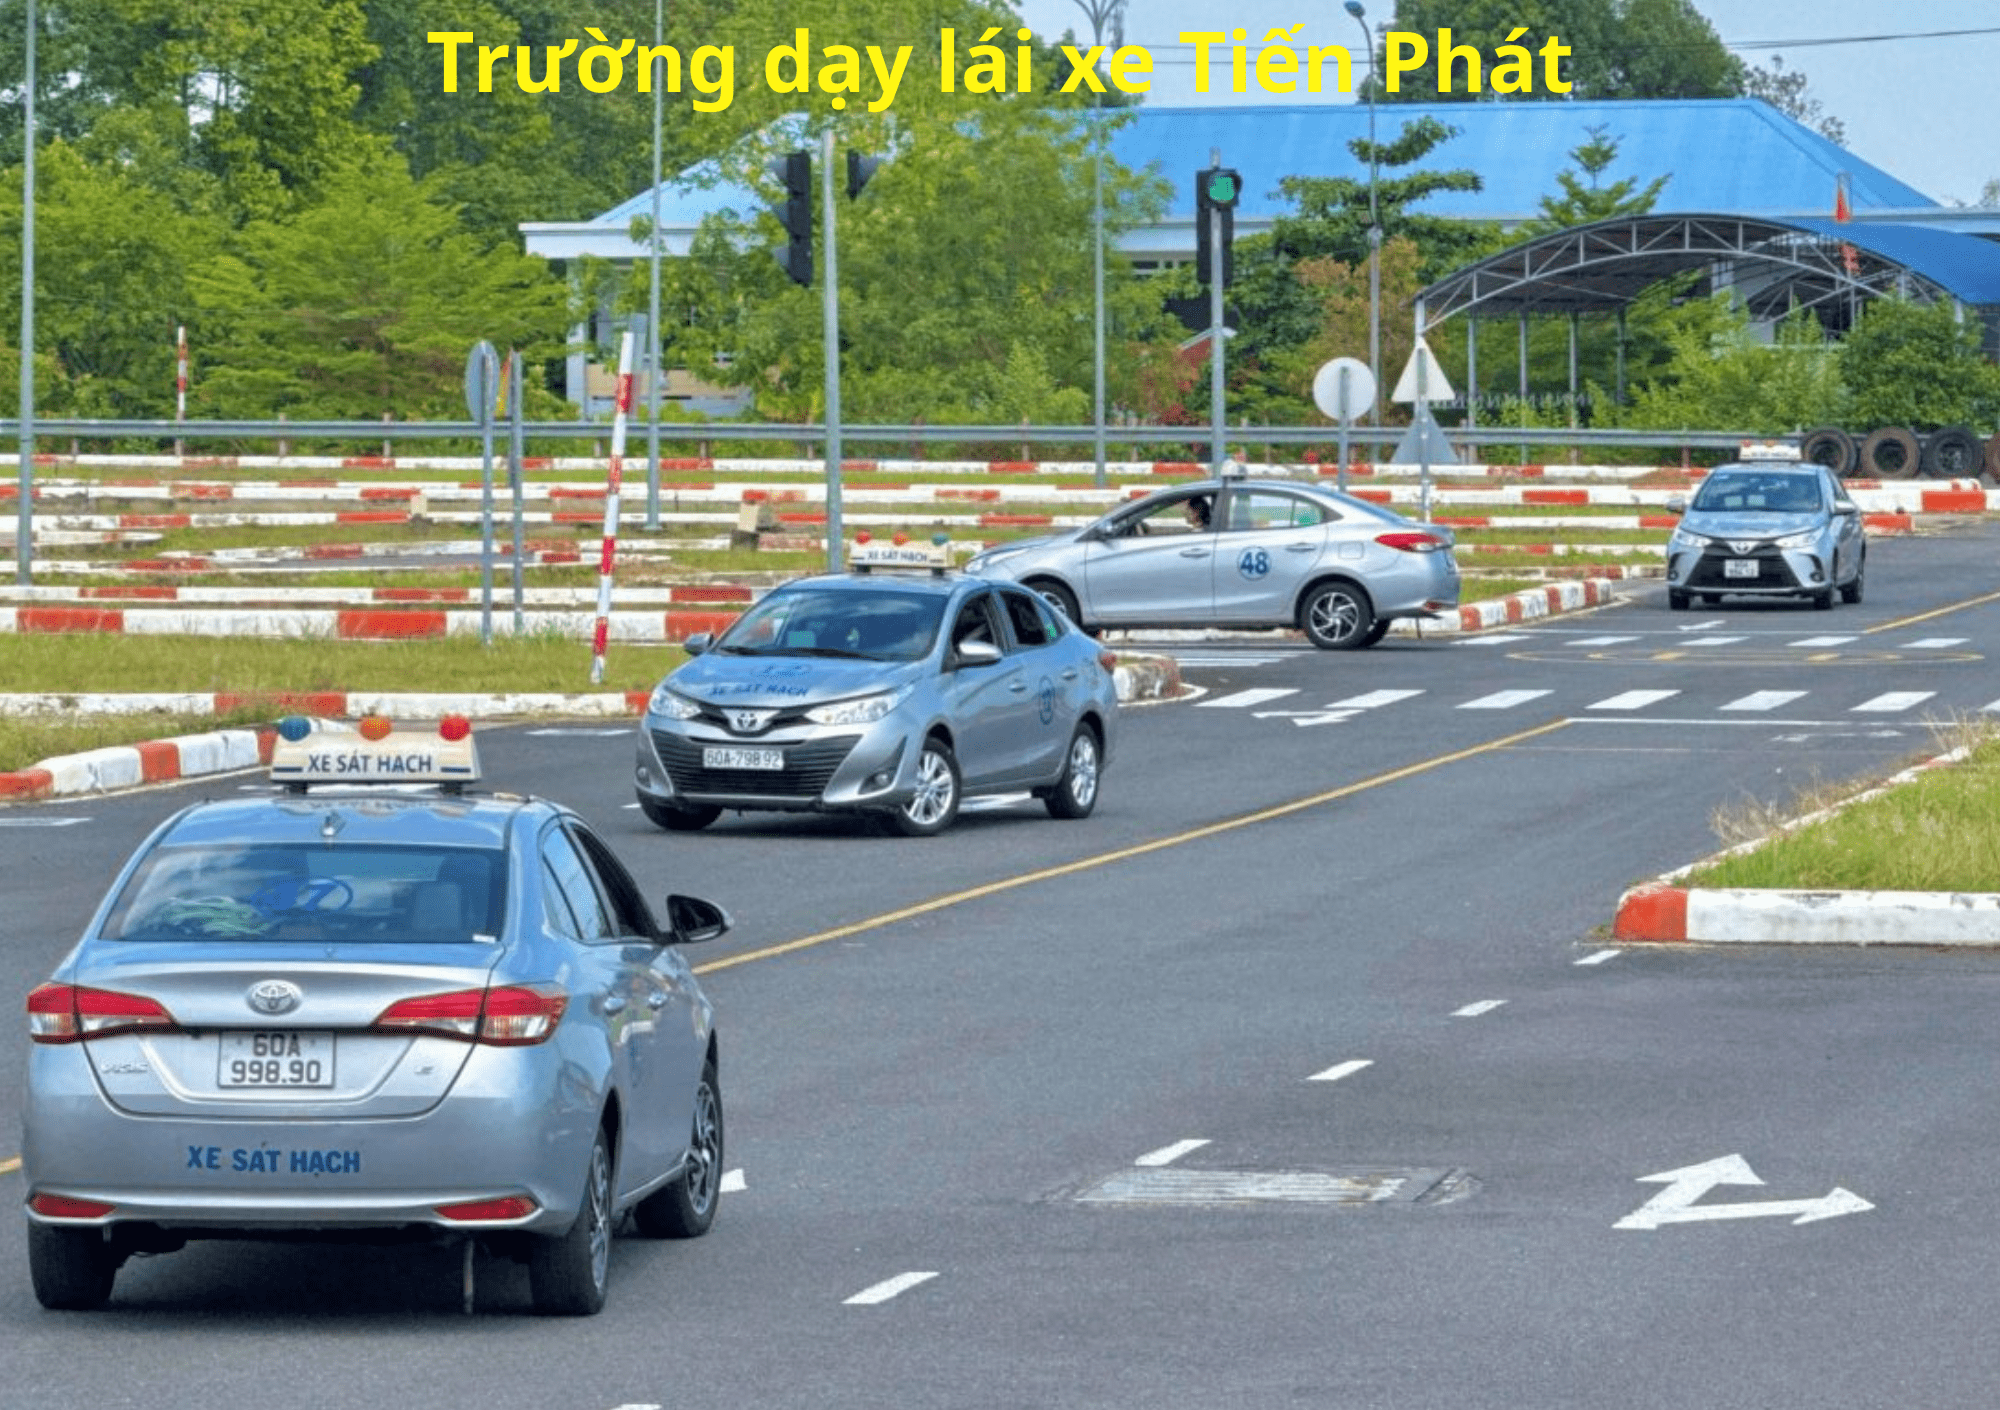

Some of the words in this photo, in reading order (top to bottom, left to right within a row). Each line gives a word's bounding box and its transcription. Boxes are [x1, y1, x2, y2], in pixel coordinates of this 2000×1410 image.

[1241, 552, 1268, 575] 48
[307, 754, 331, 773] XE
[336, 749, 371, 773] SÁT
[253, 1033, 301, 1057] 60A
[231, 1060, 321, 1083] 998.90
[187, 1145, 222, 1170] XE
[290, 1150, 361, 1178] HẠCH
